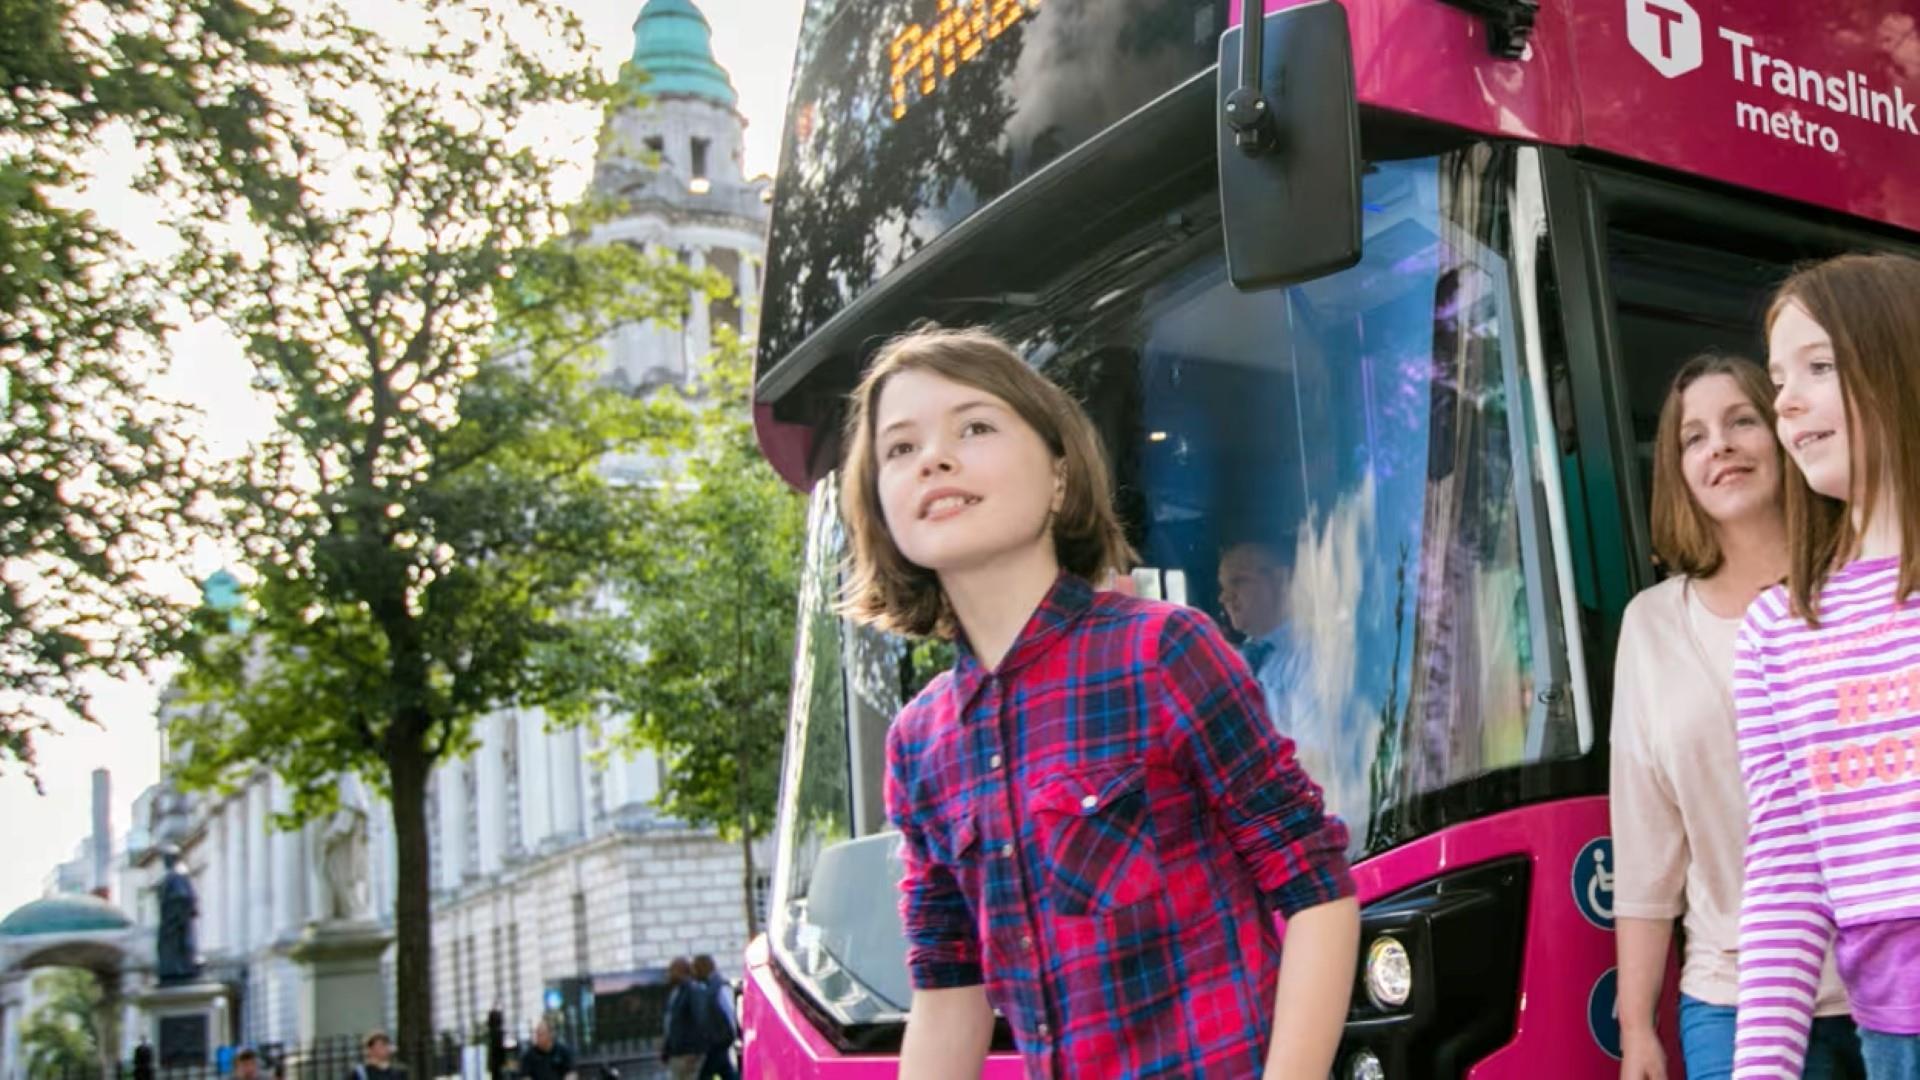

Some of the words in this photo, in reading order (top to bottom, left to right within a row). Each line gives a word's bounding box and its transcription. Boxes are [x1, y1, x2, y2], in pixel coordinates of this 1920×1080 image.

[1644, 3, 1683, 60] T
[1718, 26, 1920, 135] Translink
[1736, 101, 1839, 153] metro
